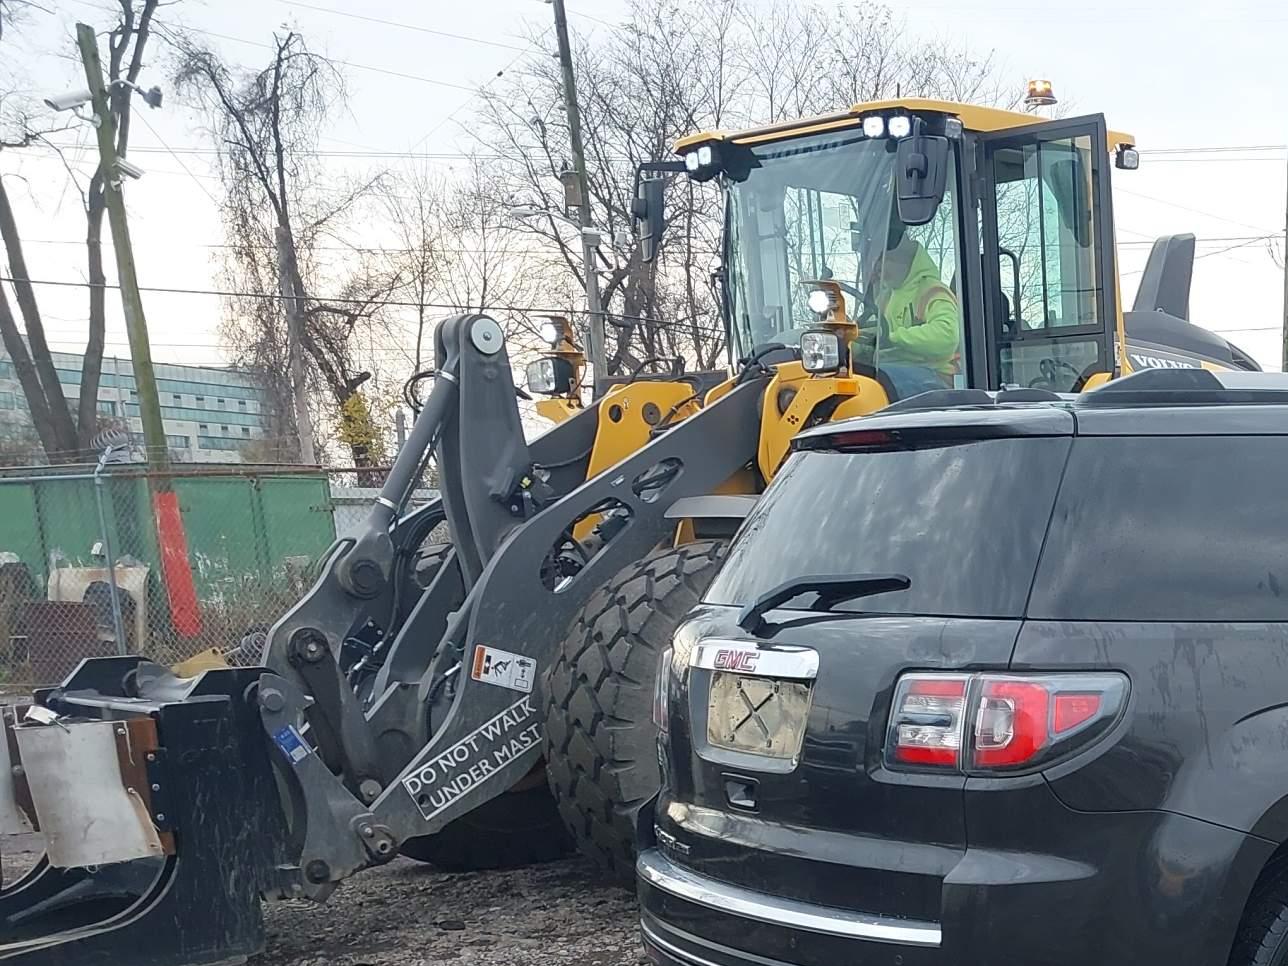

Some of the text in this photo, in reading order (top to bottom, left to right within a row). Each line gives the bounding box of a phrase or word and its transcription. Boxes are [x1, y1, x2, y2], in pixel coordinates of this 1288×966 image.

[714, 649, 760, 672] GMC
[406, 699, 537, 795] DO NOT WALK
[429, 723, 542, 808] UNDER MAST
